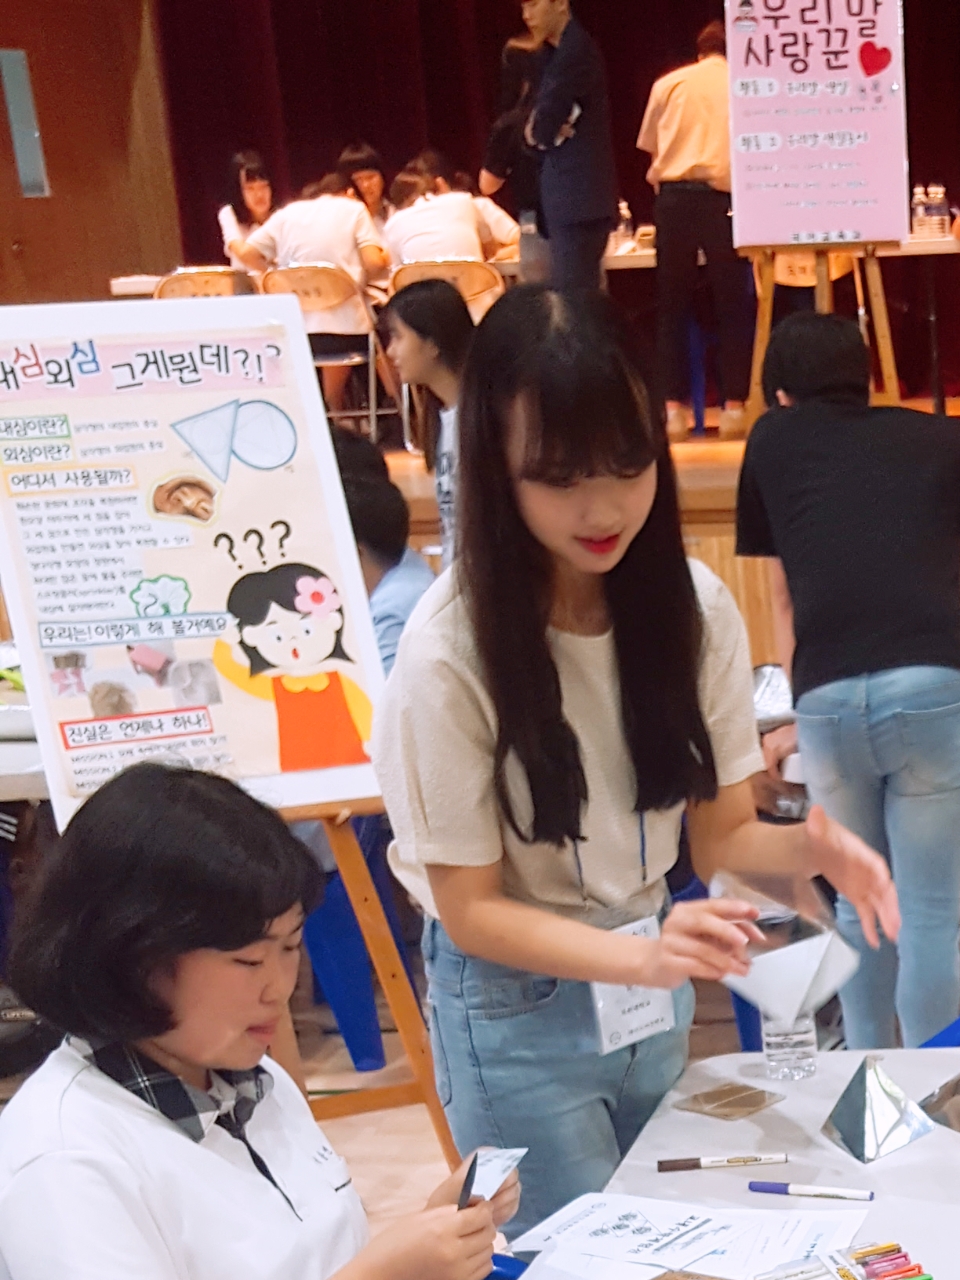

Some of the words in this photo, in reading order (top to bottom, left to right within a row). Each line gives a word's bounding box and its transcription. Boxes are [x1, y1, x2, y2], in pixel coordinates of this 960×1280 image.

[762, 0, 882, 38] 우리말
[745, 28, 849, 73] 사랑꾼
[0, 339, 101, 391] 내심외심
[0, 415, 67, 438] 내심이란?
[4, 445, 71, 463] 외심이란?
[11, 472, 57, 488] 어디서
[64, 469, 131, 487] 사용될까?
[94, 623, 139, 641] 이렇게
[148, 620, 164, 636] 해
[68, 724, 112, 745] 진실은
[119, 719, 165, 738] 언제나
[172, 712, 208, 732] 하나!
